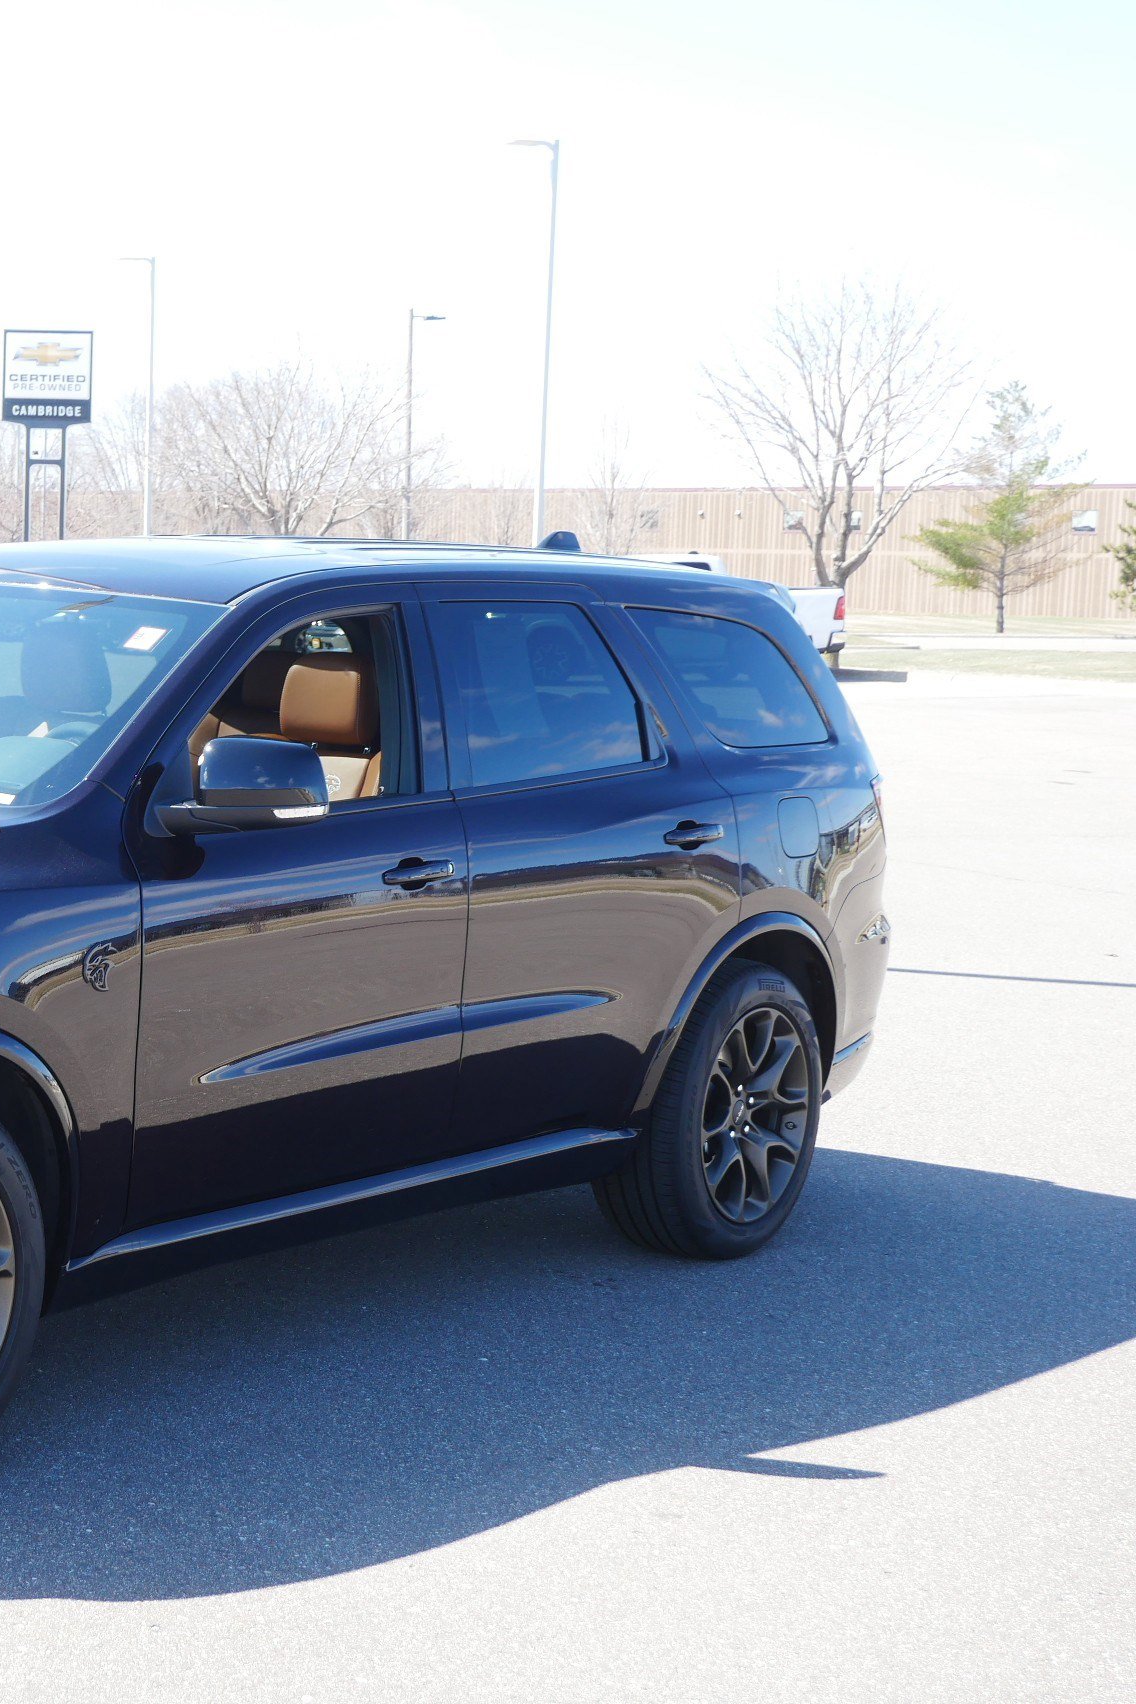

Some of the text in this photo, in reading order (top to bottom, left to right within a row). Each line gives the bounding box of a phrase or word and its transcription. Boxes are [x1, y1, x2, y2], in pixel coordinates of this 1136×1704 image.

[9, 374, 86, 383] CERTIFIED
[13, 383, 82, 391] PRE-OWNED
[12, 405, 82, 417] CAMBRIDGE
[757, 979, 786, 993] PIRELLI
[7, 1157, 38, 1220] ZERO
